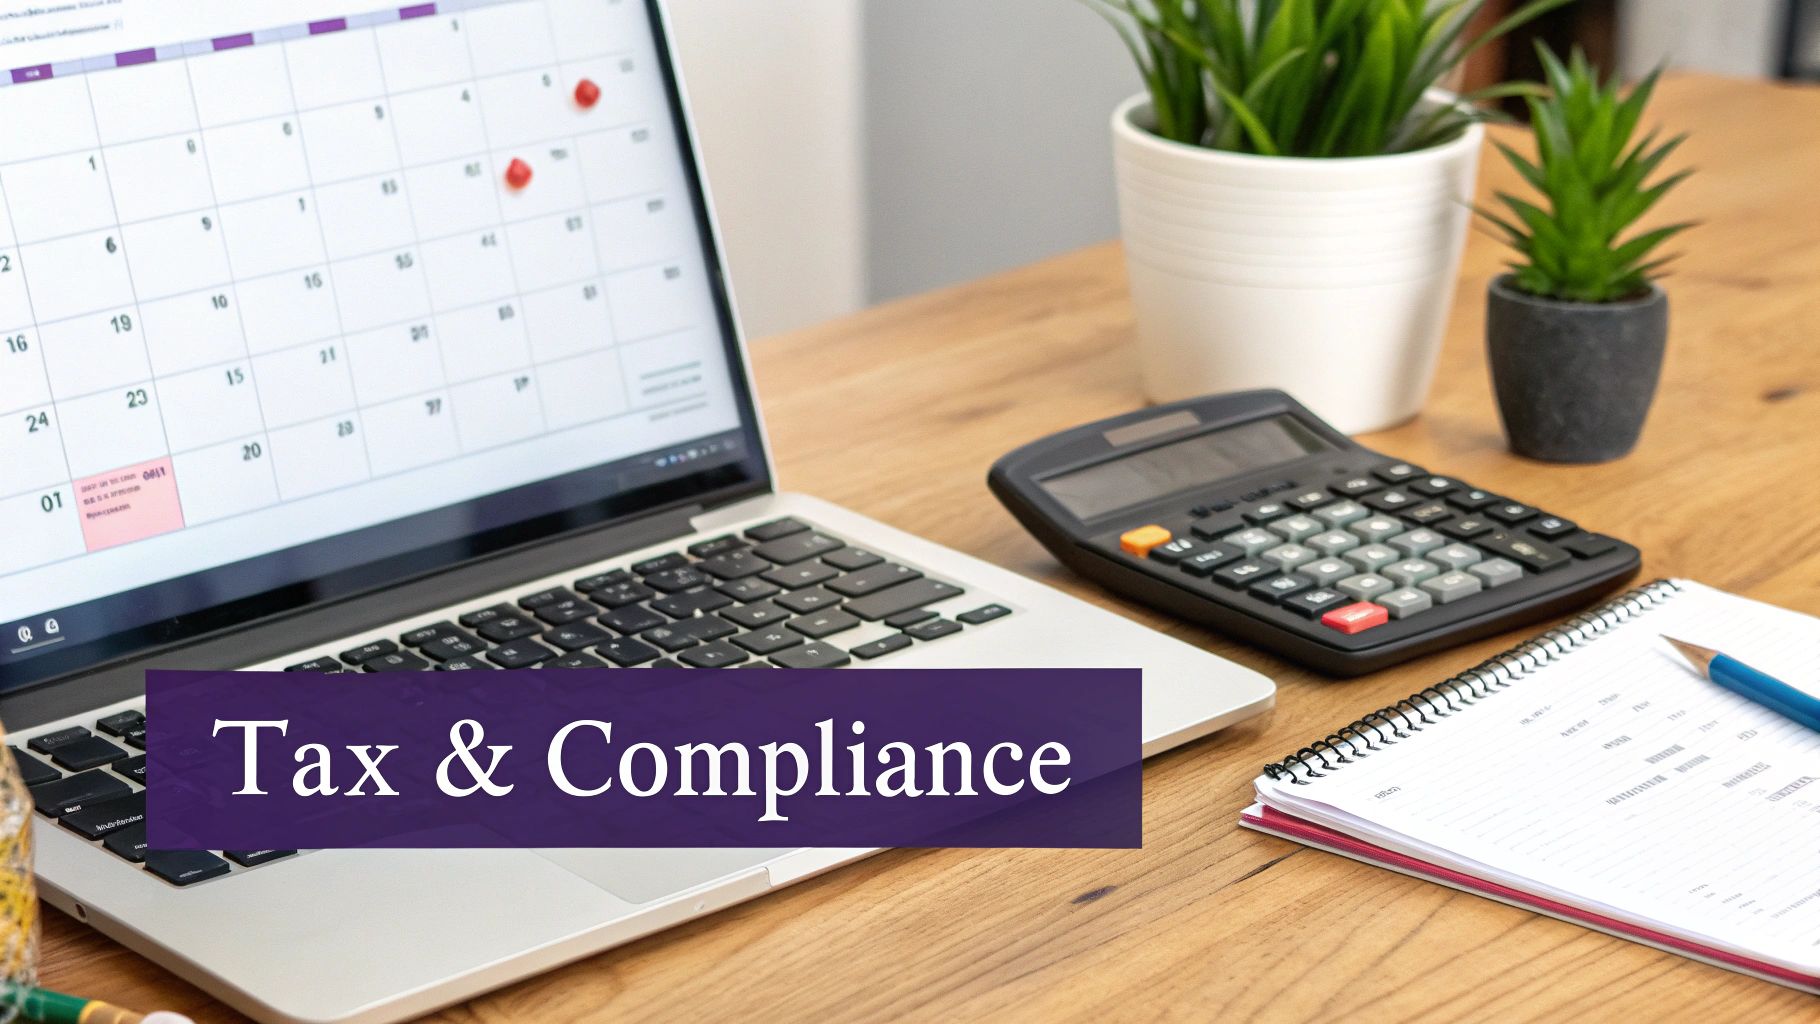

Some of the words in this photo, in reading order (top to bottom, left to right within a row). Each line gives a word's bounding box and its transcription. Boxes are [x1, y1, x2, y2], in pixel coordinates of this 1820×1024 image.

[105, 236, 117, 254] 6
[211, 294, 228, 310] 10
[110, 314, 132, 334] 19
[6, 334, 28, 353] 16
[226, 368, 244, 386] 15
[126, 388, 148, 409] 23
[25, 411, 49, 433] 24
